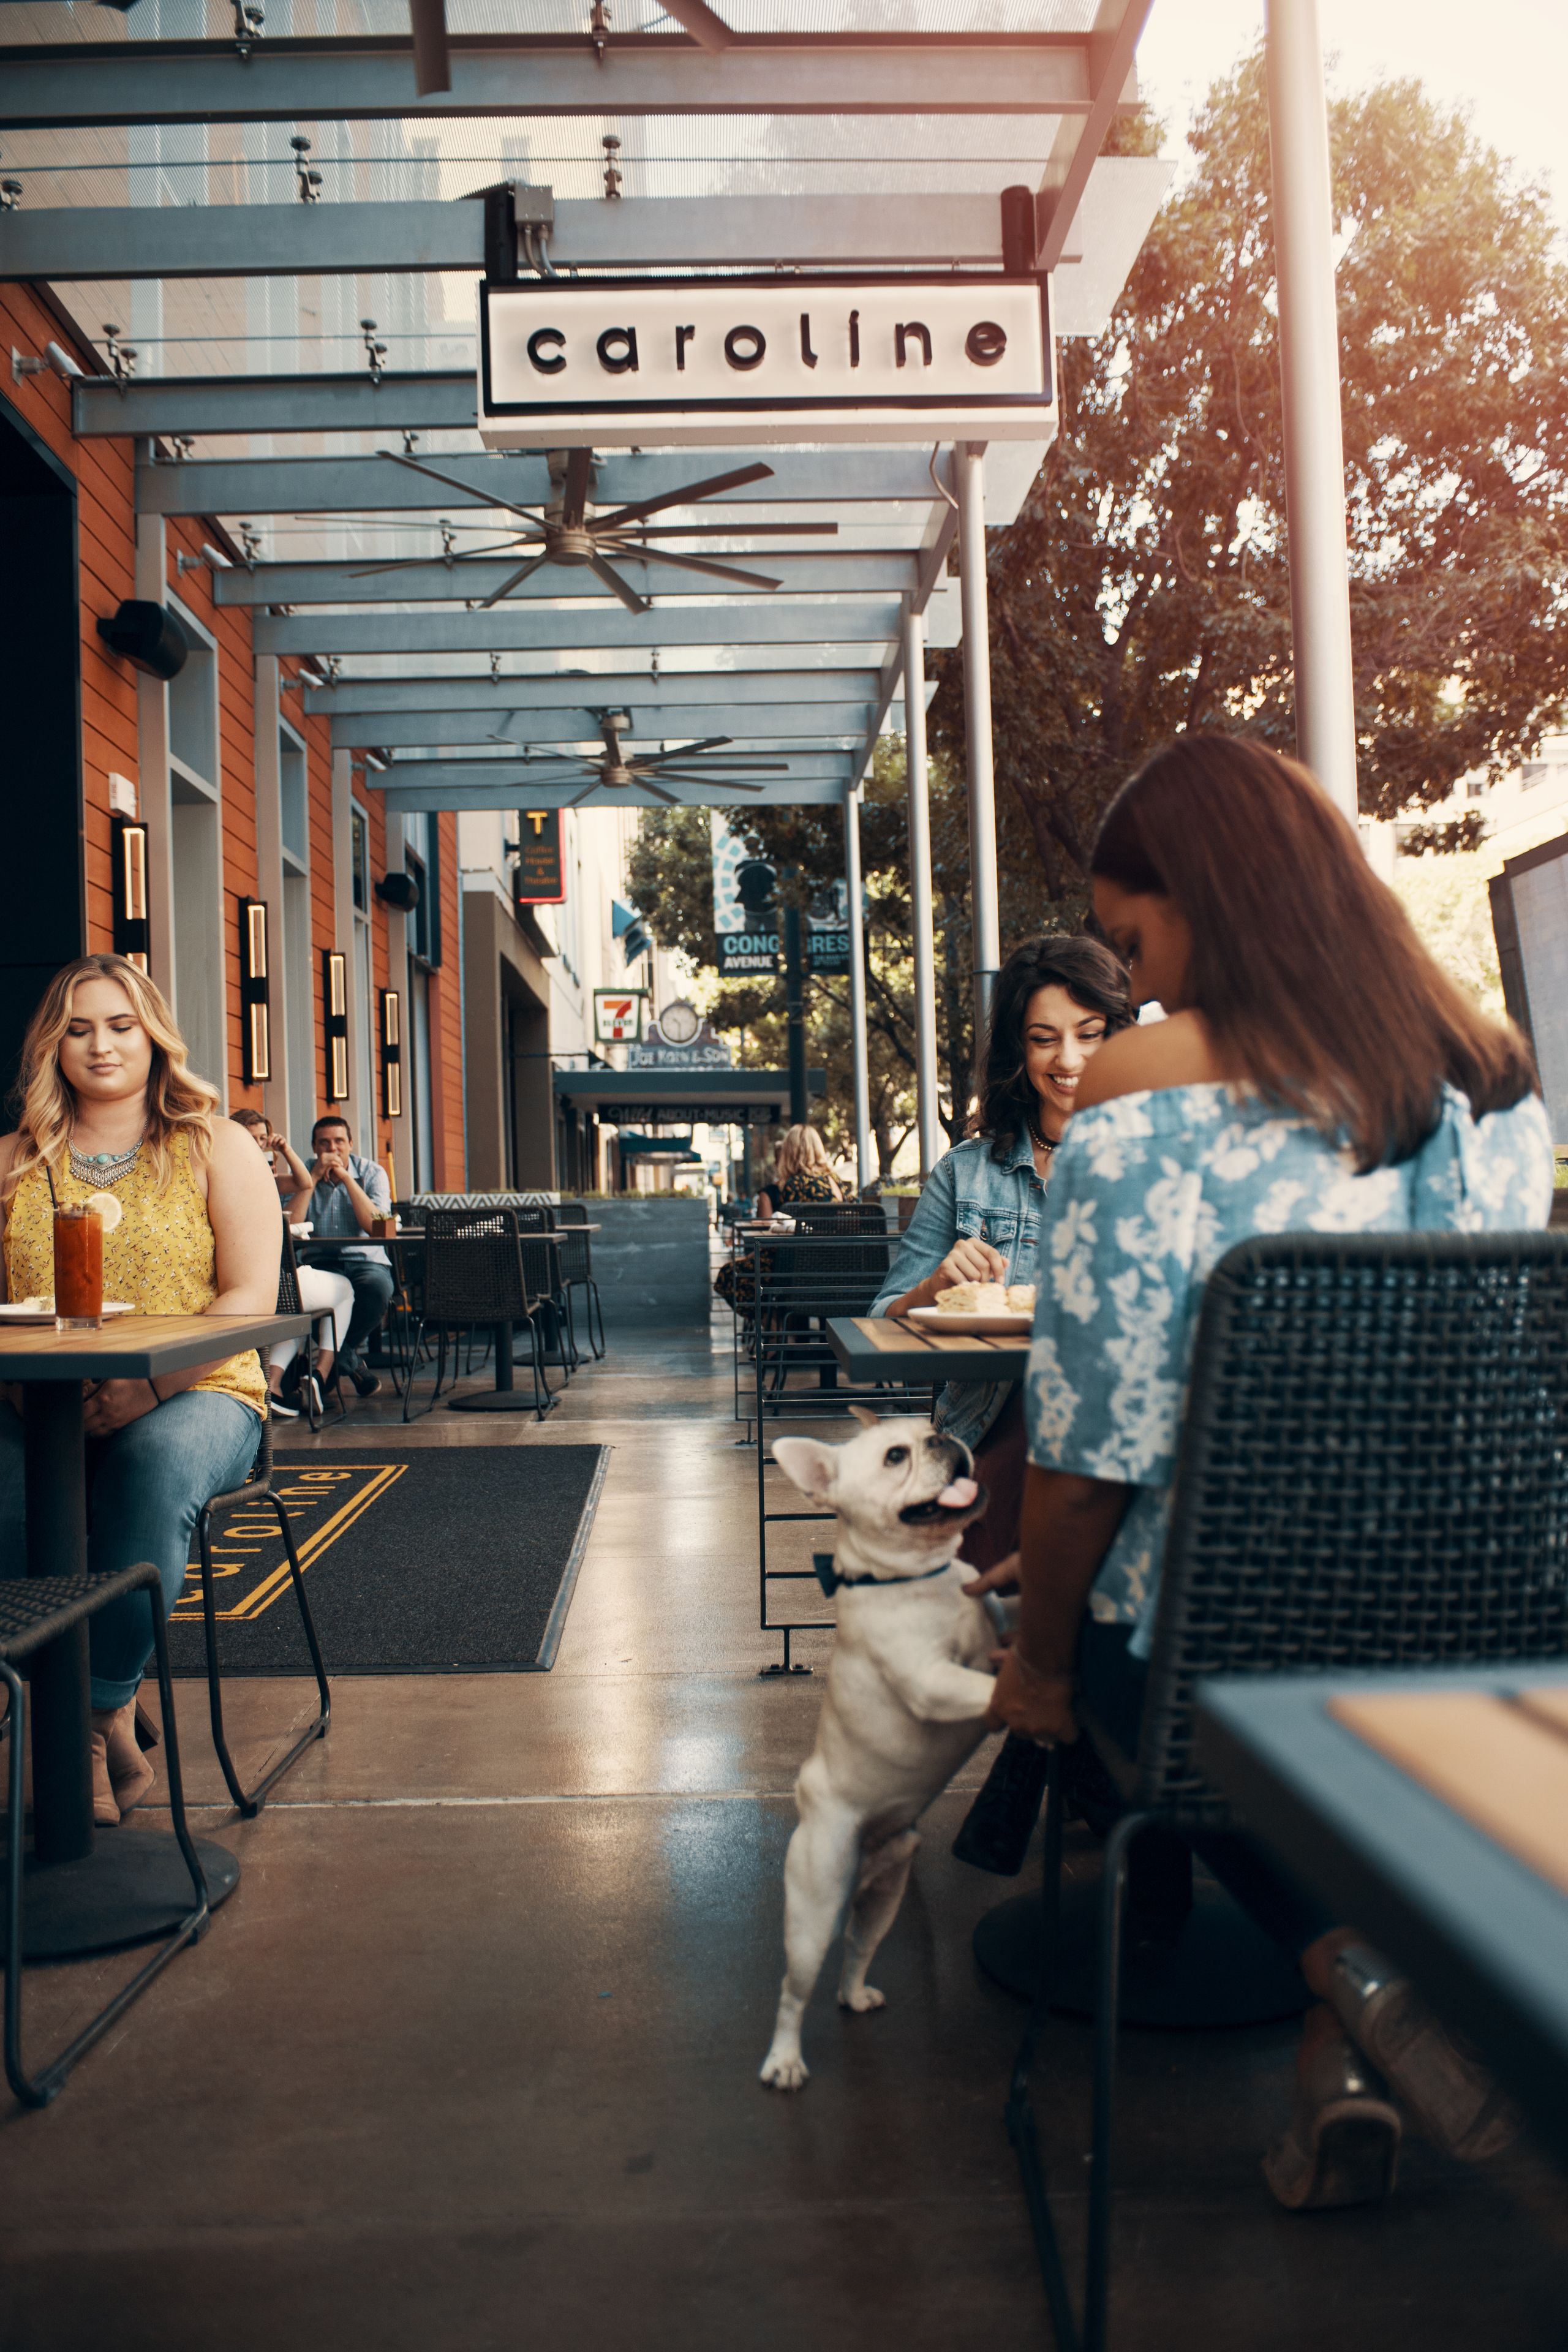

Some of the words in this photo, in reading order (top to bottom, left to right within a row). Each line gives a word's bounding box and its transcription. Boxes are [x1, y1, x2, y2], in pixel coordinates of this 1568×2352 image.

[527, 309, 1008, 374] caroline
[526, 811, 548, 834] T
[807, 935, 850, 952] RES
[723, 955, 774, 969] AVENUE
[603, 1000, 631, 1039] 7
